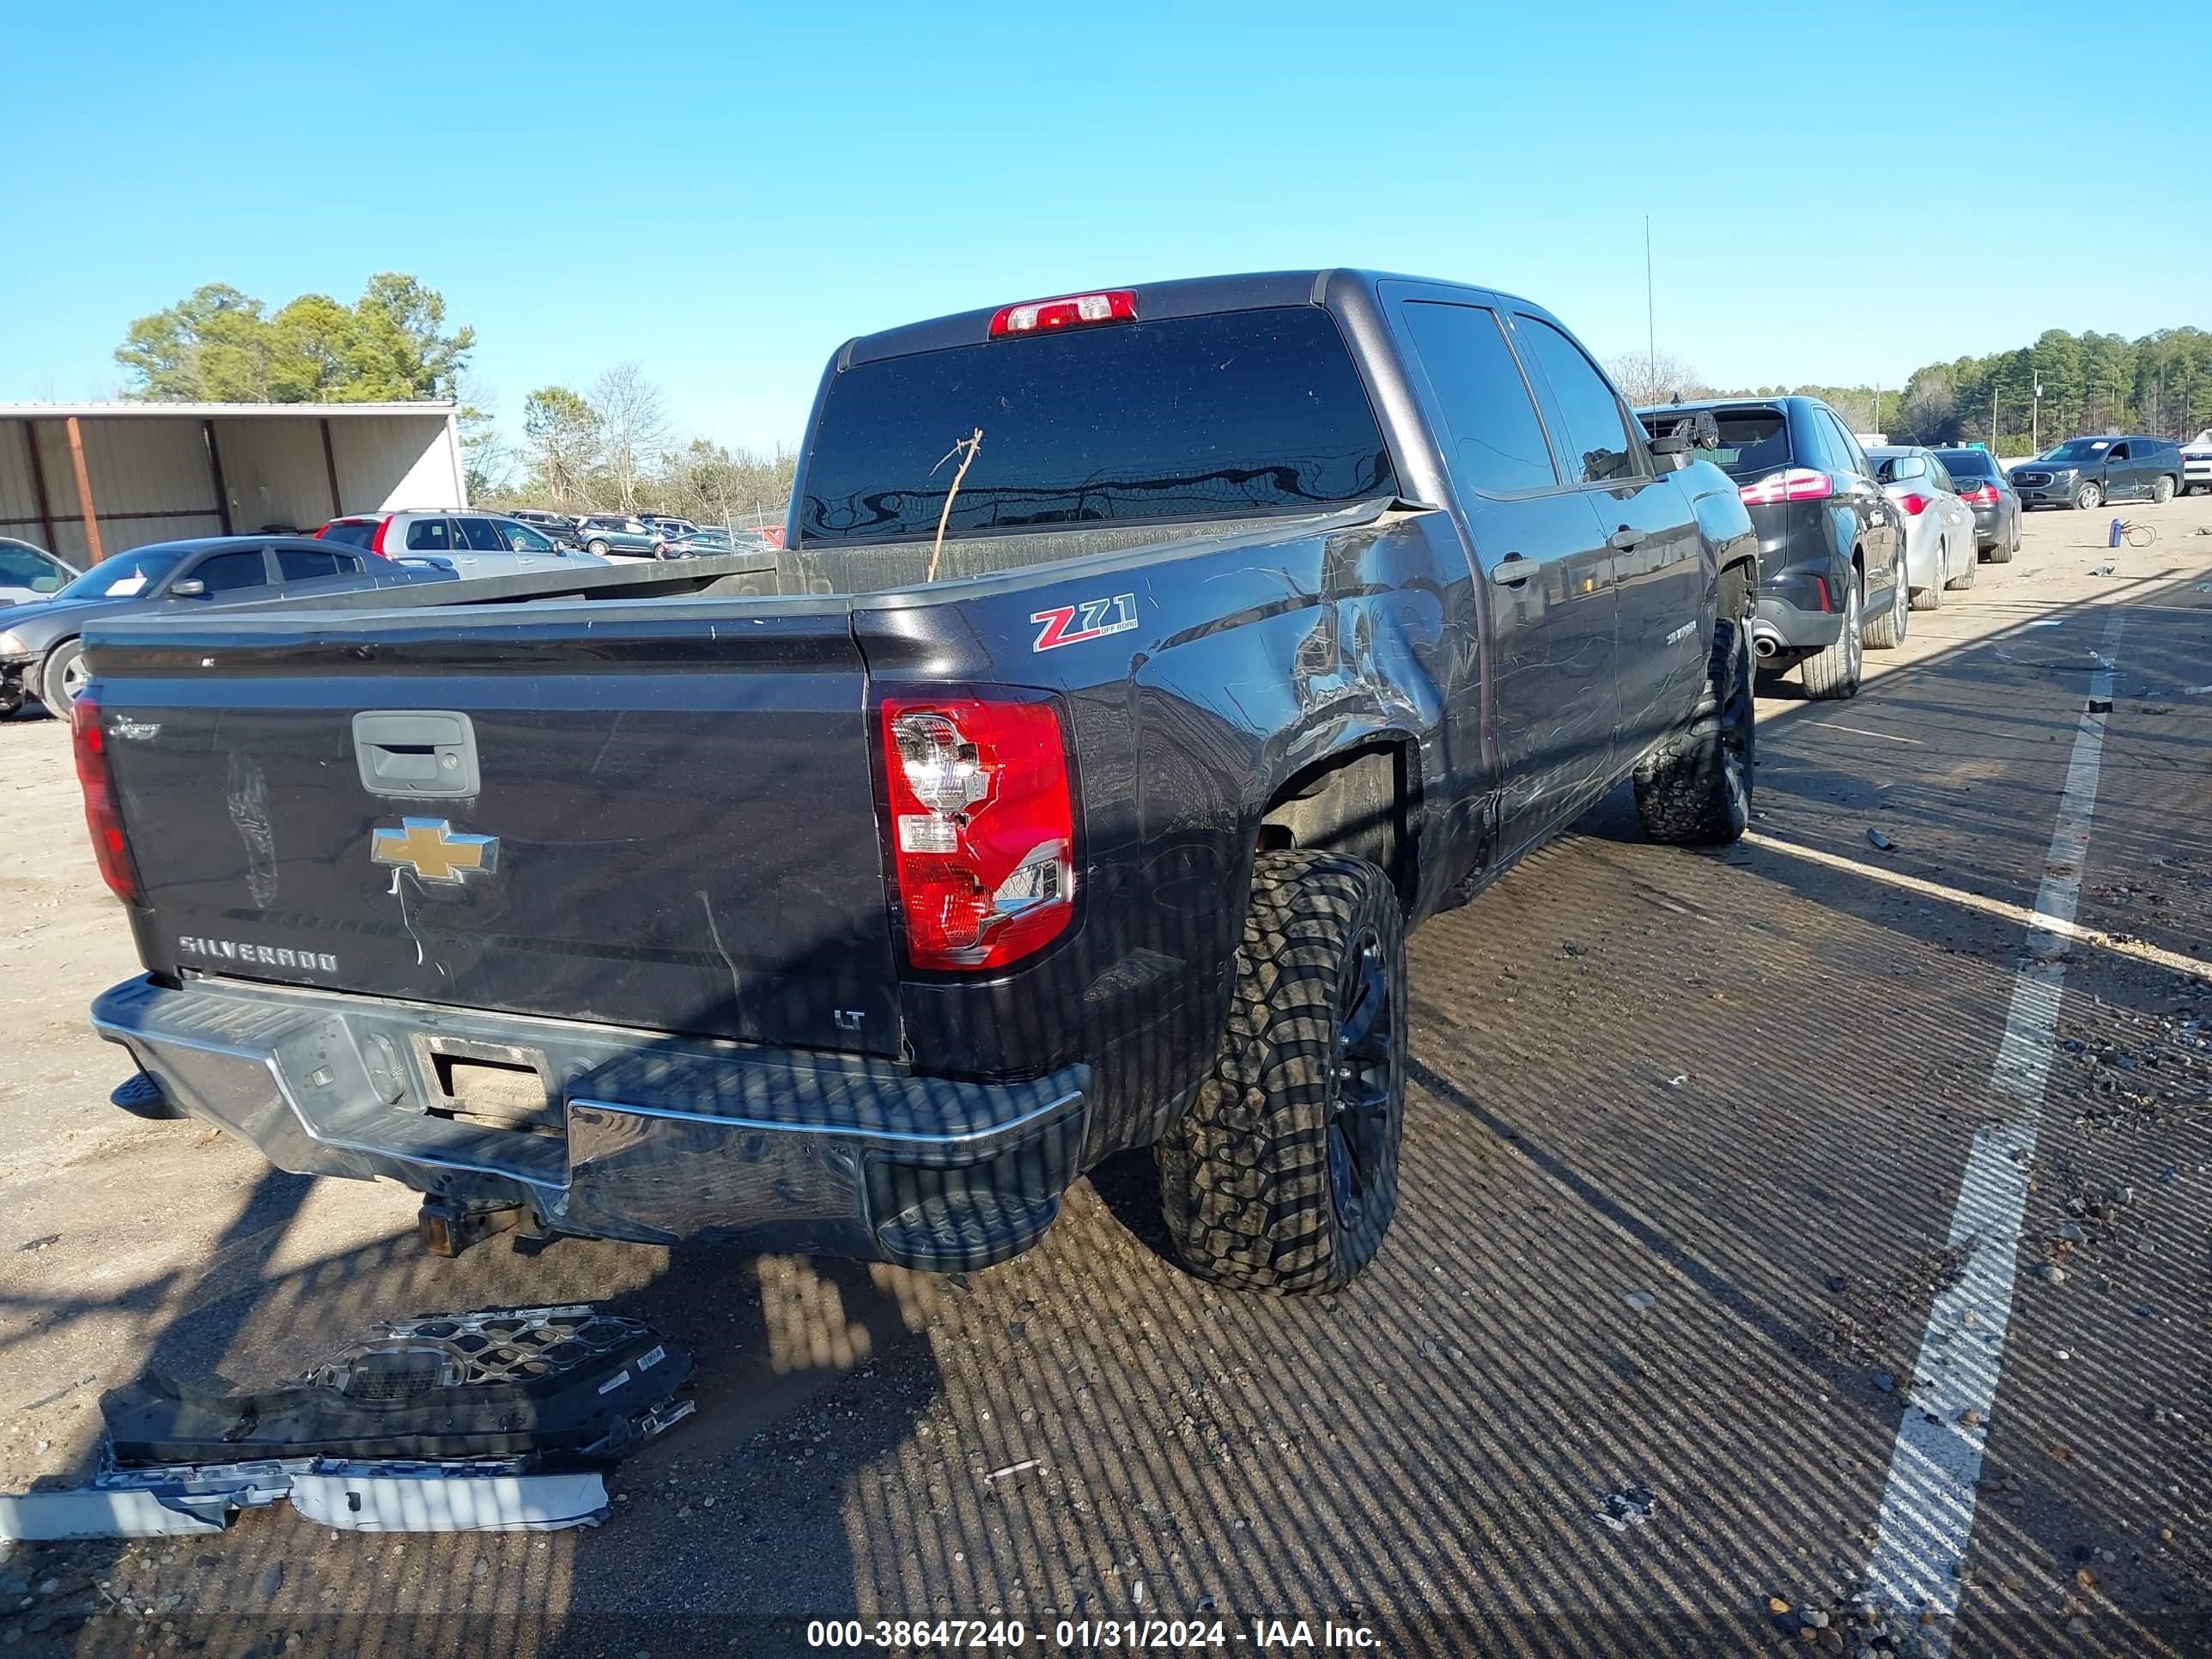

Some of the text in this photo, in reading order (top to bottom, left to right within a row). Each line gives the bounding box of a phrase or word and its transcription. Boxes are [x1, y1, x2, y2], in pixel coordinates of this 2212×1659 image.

[1030, 592, 1138, 653] Z71
[1101, 620, 1137, 635] OFF ROAD
[179, 936, 338, 972] SILVERADO
[834, 1009, 866, 1030] LT
